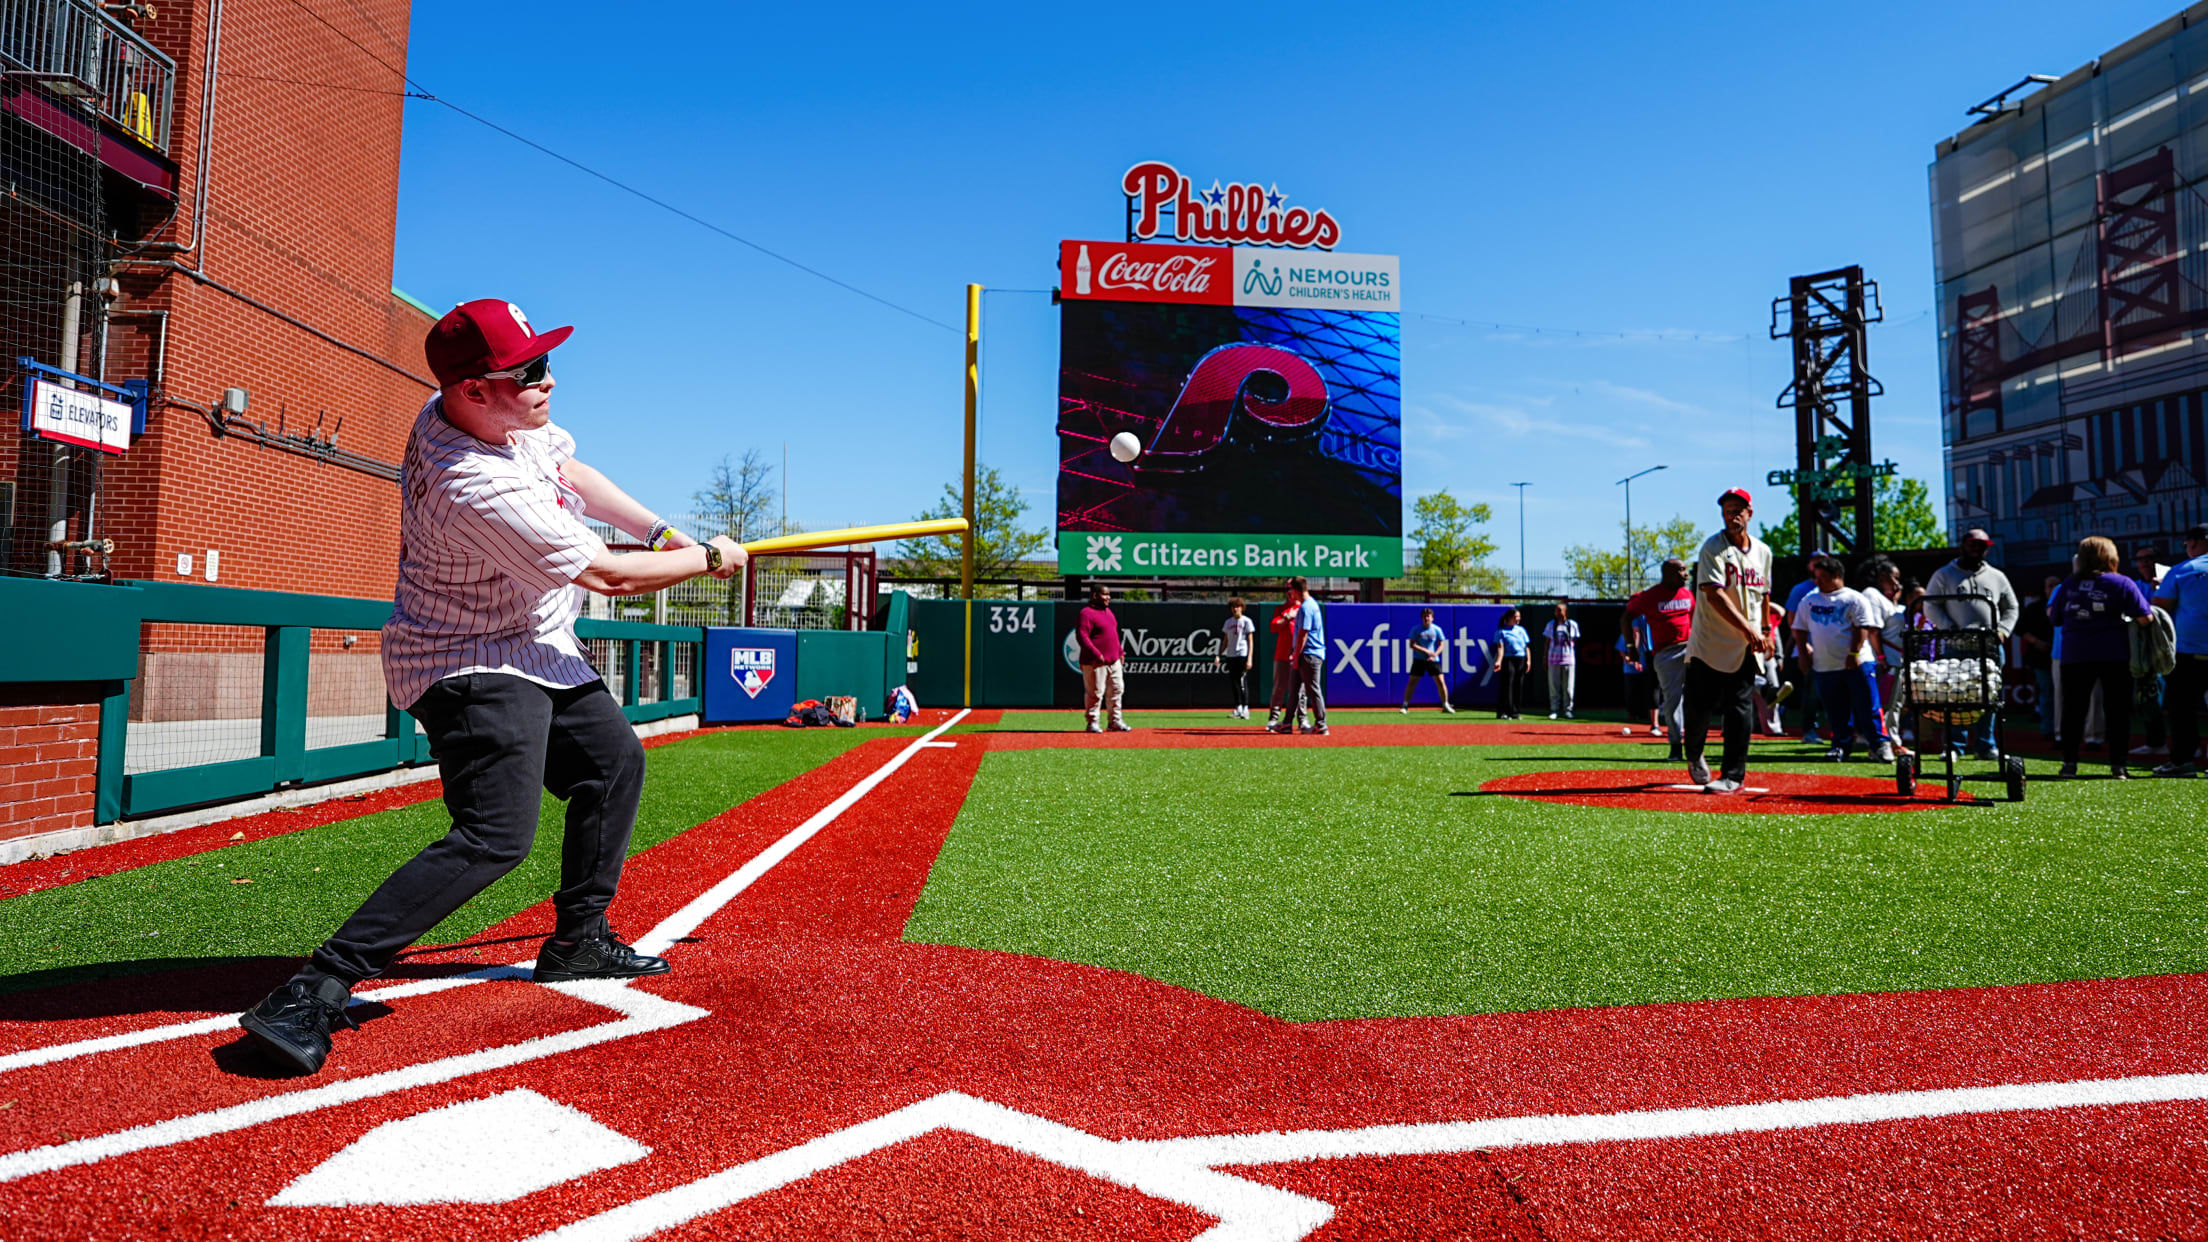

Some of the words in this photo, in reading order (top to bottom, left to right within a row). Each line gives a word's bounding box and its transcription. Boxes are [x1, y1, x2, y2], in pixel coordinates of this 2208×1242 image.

[1122, 160, 1341, 249] Phillies
[1098, 252, 1217, 293] Coca-Cola
[1289, 267, 1390, 287] NEMOURS
[1289, 286, 1350, 300] CHILDREN'S
[1352, 289, 1391, 301] HEALTH
[68, 404, 119, 432] ELEVATORS
[1133, 542, 1238, 566] Citizens
[1244, 543, 1308, 567] Bank
[1315, 544, 1370, 568] Park
[990, 606, 1036, 633] 334
[734, 651, 772, 664] MLB
